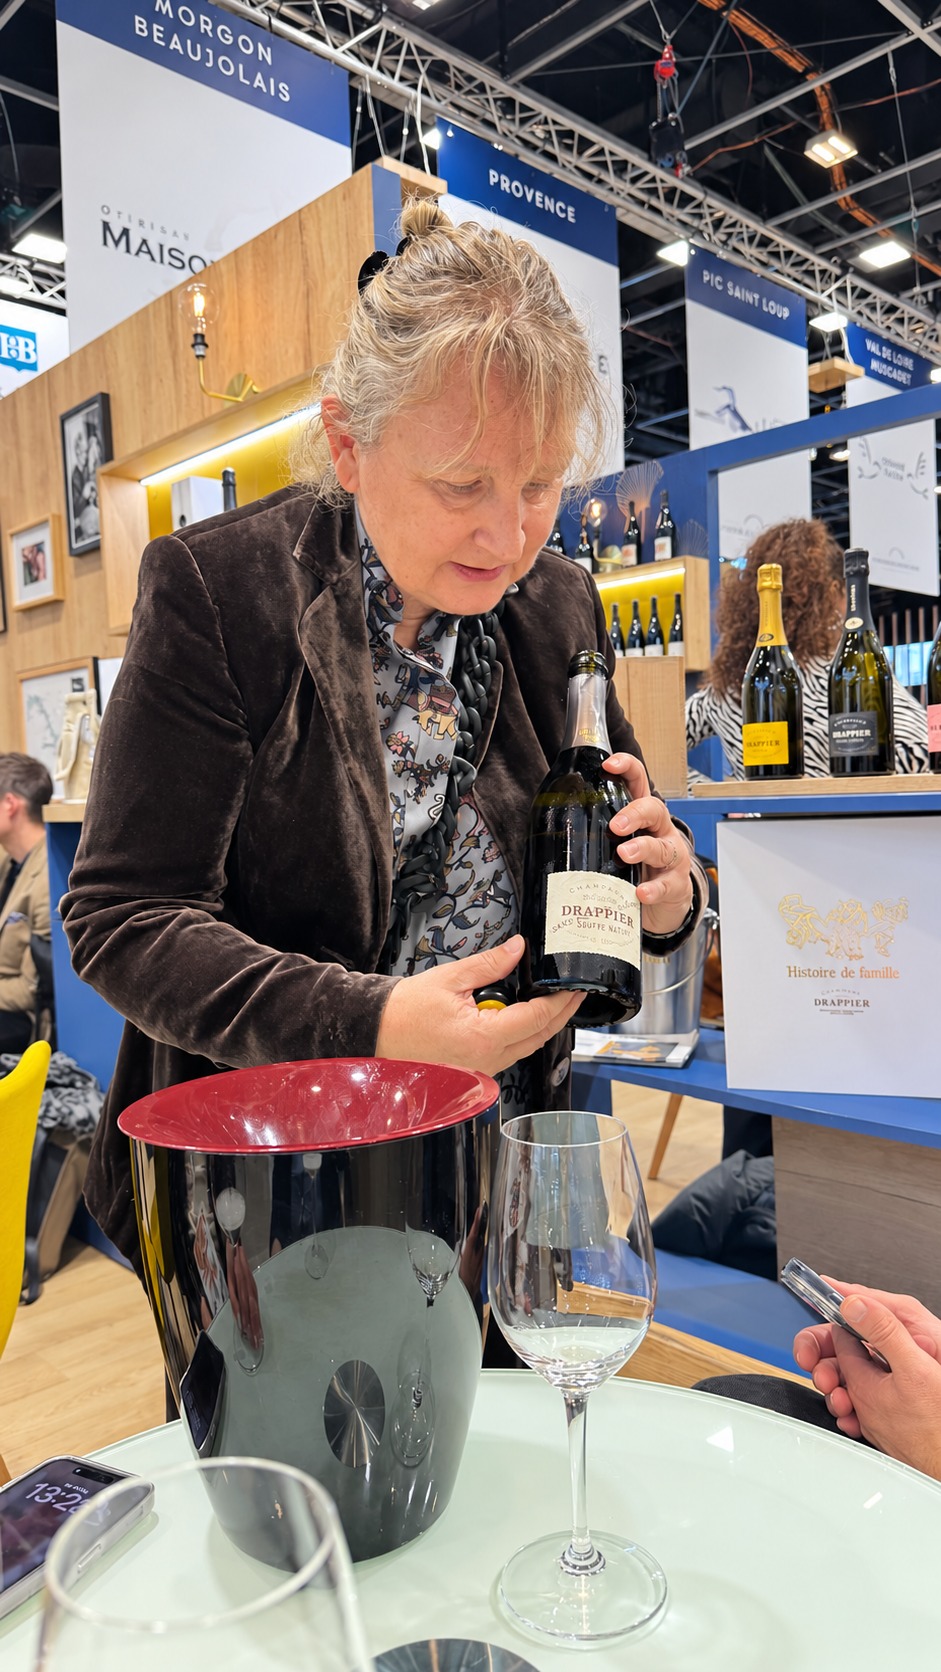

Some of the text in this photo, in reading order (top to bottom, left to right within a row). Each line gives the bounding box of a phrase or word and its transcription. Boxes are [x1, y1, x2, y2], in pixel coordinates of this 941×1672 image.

[154, 0, 273, 65] MORGON
[134, 15, 290, 102] BEAUJOLAIS
[489, 168, 577, 224] PROVENCE
[101, 219, 215, 275] MAISO
[703, 269, 790, 320] PIC SAINT LOUP
[865, 338, 881, 357] VAL
[893, 351, 914, 371] LOIRE
[562, 904, 634, 929] DRAPPIER
[787, 965, 900, 979] Histoire de famille
[814, 998, 870, 1009] DRAPPIER
